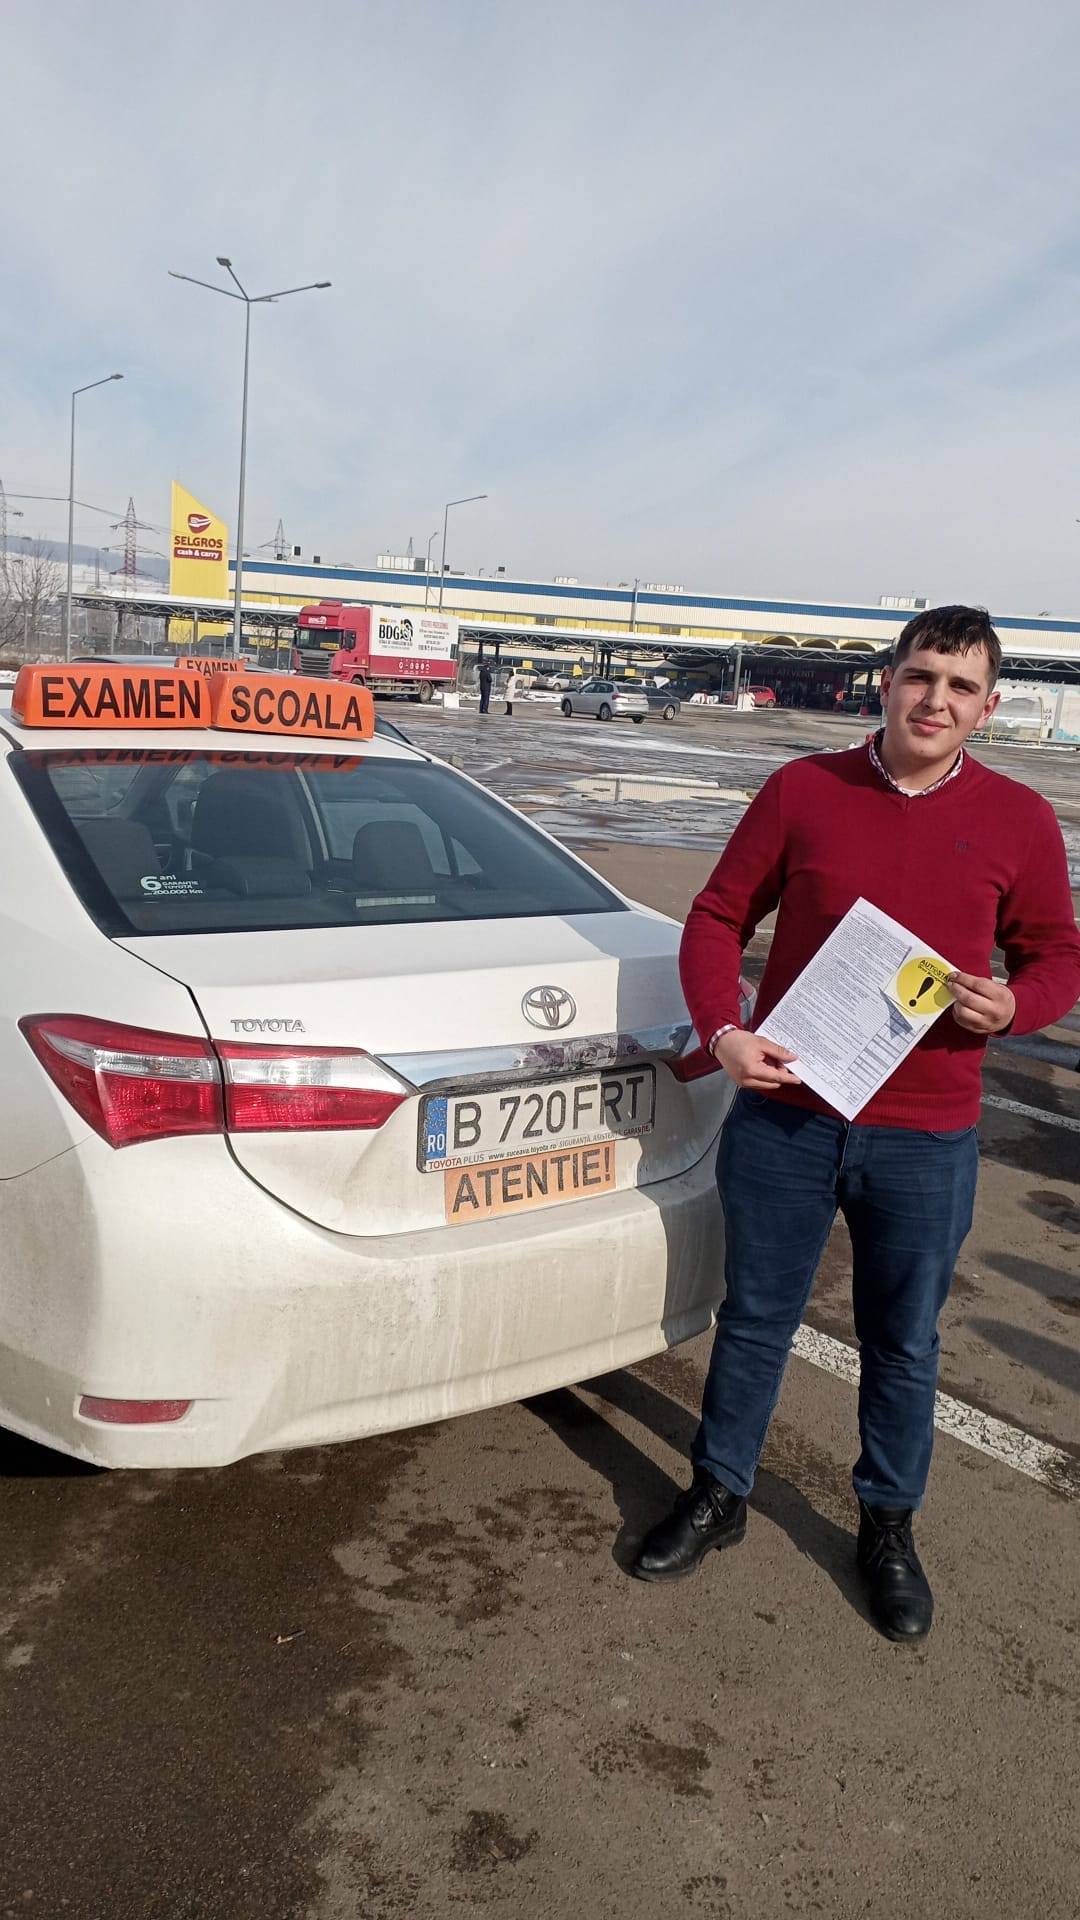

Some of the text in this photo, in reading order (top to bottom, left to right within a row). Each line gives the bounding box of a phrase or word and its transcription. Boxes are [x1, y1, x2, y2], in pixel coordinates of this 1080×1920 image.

[174, 536, 223, 548] SELGROS
[200, 551, 220, 559] carry
[379, 624, 399, 640] BDG
[186, 659, 238, 677] EXAMEN
[41, 677, 200, 718] EXAMEN
[231, 685, 362, 732] SCOALA
[140, 876, 161, 891] 6
[231, 1019, 306, 1033] TOYOTA
[453, 1101, 481, 1149] B
[427, 1133, 446, 1153] RO
[428, 1157, 463, 1170] TOYOTA
[463, 1154, 485, 1165] PLUS
